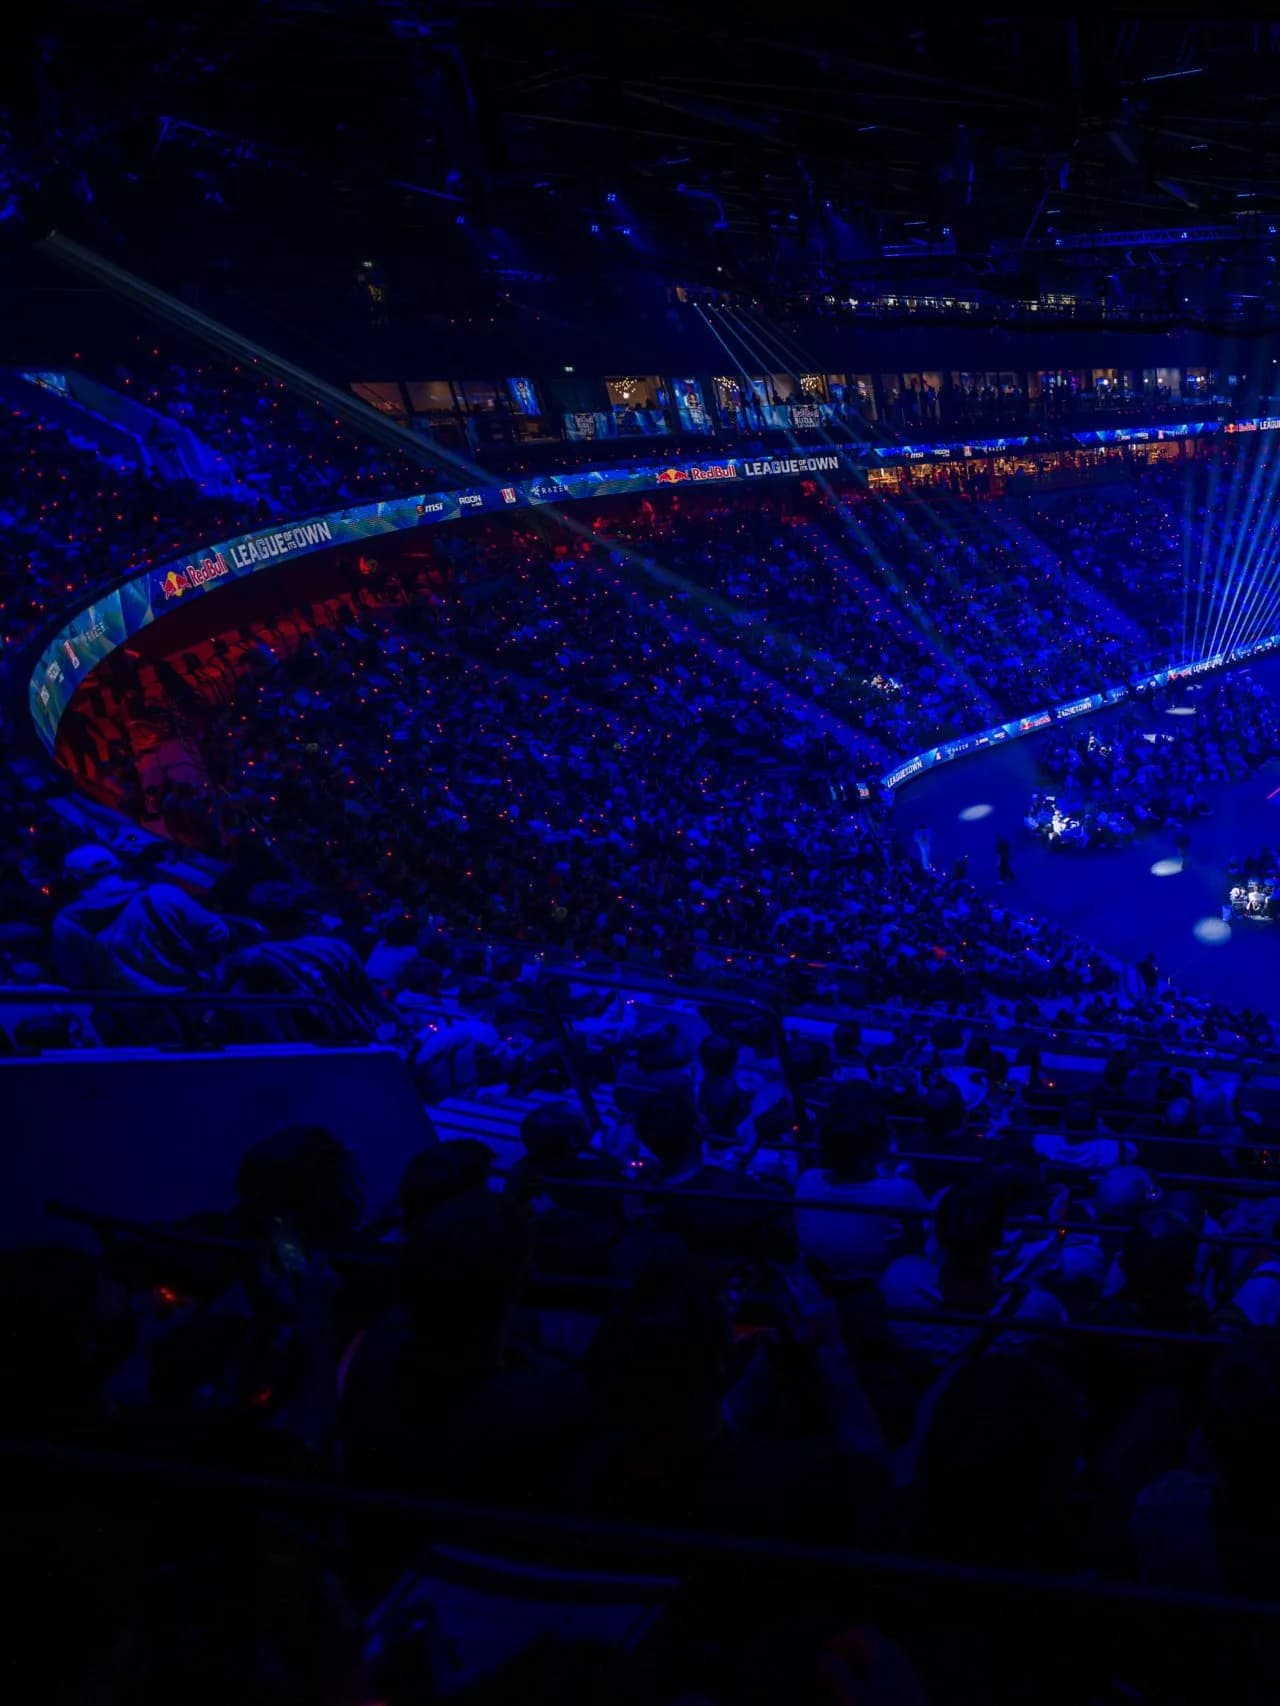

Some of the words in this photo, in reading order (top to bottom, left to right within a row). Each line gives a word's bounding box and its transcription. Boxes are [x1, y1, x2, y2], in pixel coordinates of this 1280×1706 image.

[744, 459, 799, 476] LEAGUE
[806, 456, 839, 471] OWN
[424, 502, 444, 513] msi
[230, 534, 288, 568] LEAGUE
[292, 522, 332, 548] OWN
